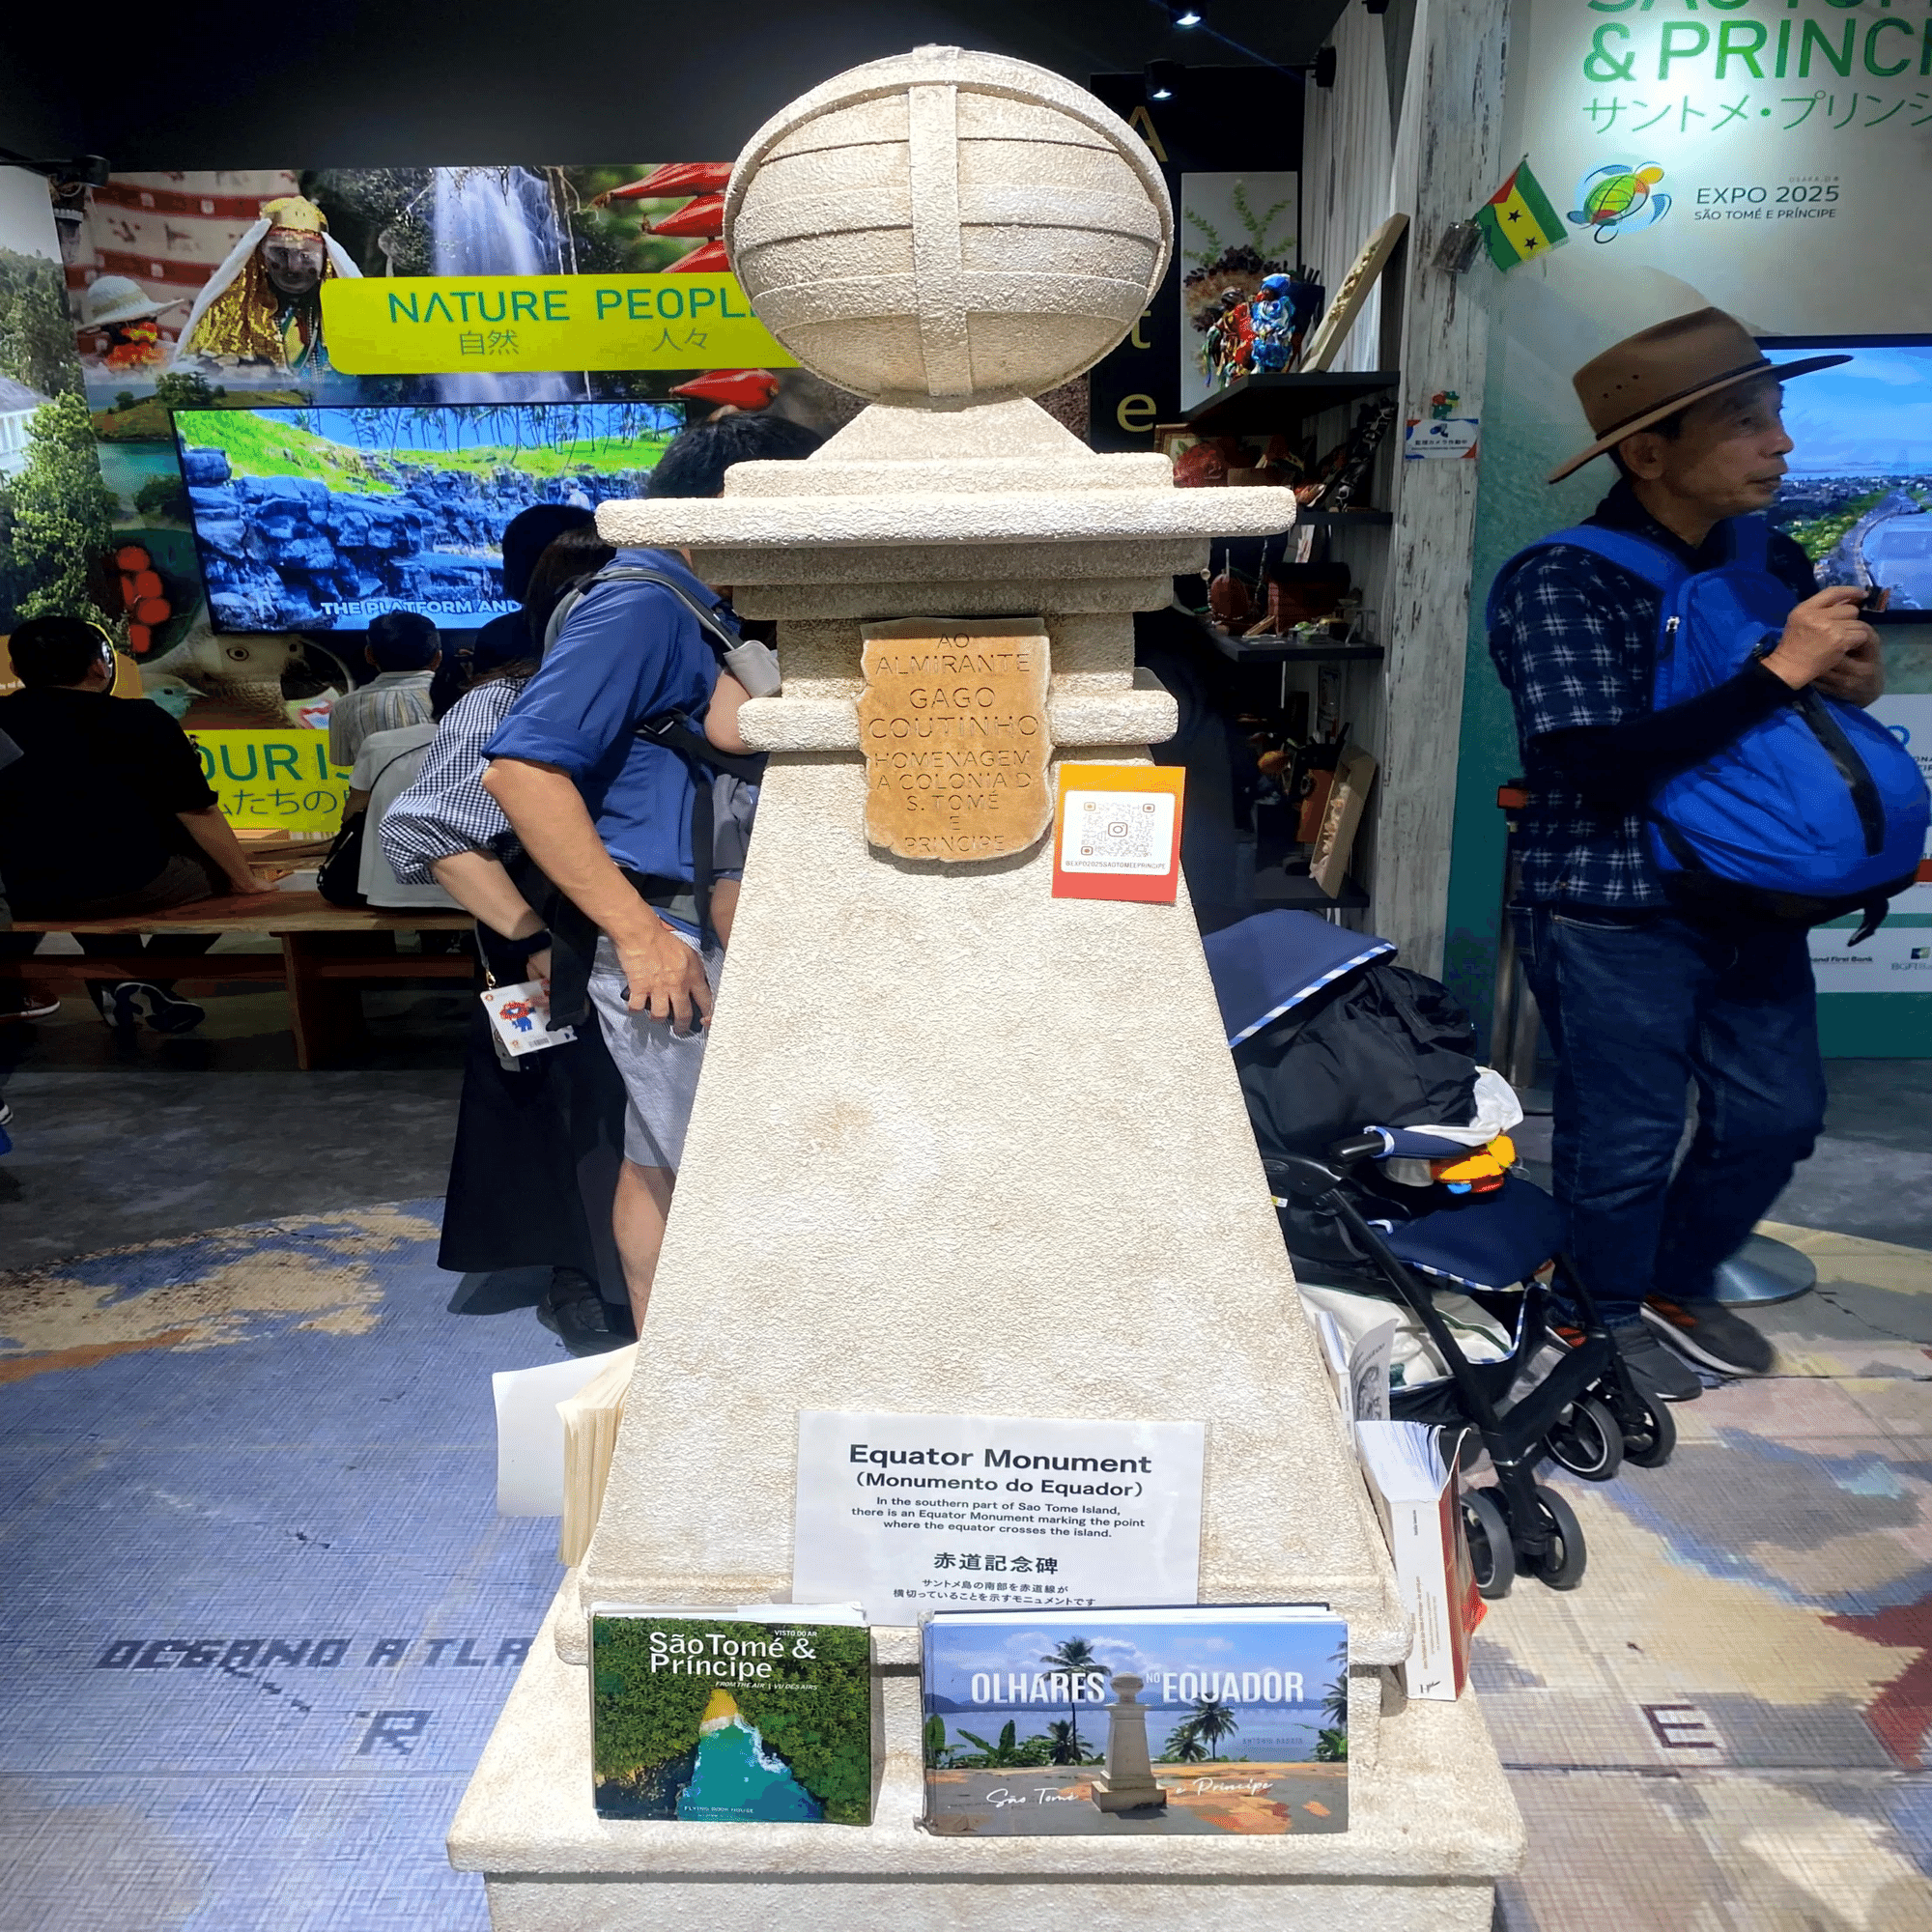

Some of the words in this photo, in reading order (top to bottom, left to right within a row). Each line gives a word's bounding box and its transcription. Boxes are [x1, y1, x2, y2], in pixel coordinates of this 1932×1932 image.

[1582, 21, 1636, 82] &
[1696, 186, 1767, 204] EXPO
[1776, 185, 1839, 203] 2025
[1694, 209, 1721, 220] SÃO
[1725, 208, 1762, 219] TOMÉ
[1766, 210, 1774, 219] E
[1777, 207, 1836, 218] PRÍNCIPE
[388, 290, 570, 324] NATURE
[596, 287, 756, 320] PEOPL
[459, 329, 519, 355] 自然
[651, 327, 709, 353] 人々
[321, 602, 361, 615] THE
[367, 600, 473, 614] PLATFORM
[475, 600, 524, 613] AND
[937, 633, 970, 649] AO
[875, 653, 1030, 674] ALMIRANTE
[909, 687, 996, 709] GAGO
[868, 716, 1039, 739] COUTINHO
[316, 743, 351, 781] I
[874, 751, 1030, 769] HOMENAGEM
[876, 775, 891, 790] A
[898, 773, 1009, 790] COLONIA
[222, 788, 351, 815] たちの
[906, 795, 925, 811] S.
[931, 790, 999, 810] TOMÉ
[950, 815, 961, 831] E
[904, 836, 1005, 853] PRINCIPE
[850, 1443, 974, 1468] Equator
[984, 1448, 1151, 1473] Monument
[857, 1471, 998, 1491] (Monumento
[1006, 1478, 1034, 1492] do
[1041, 1479, 1143, 1497] Equador)
[876, 1496, 888, 1505] In
[892, 1497, 911, 1506] the
[915, 1498, 969, 1508] southern
[973, 1501, 998, 1510] part
[1018, 1502, 1040, 1511] Sao
[1045, 1503, 1078, 1513] Tome
[1082, 1505, 1121, 1516] Island,
[851, 1507, 884, 1517] there
[919, 1509, 966, 1520] Equator
[970, 1512, 1034, 1522] Monument
[1037, 1516, 1086, 1526] marking
[1090, 1518, 1110, 1526] the
[1114, 1519, 1145, 1528] point
[883, 1520, 921, 1529] where
[924, 1520, 944, 1530] the
[948, 1522, 995, 1532] equator
[999, 1525, 1046, 1535] crosses
[1050, 1527, 1070, 1536] the
[1073, 1528, 1112, 1538] island.
[934, 1551, 1059, 1575] 赤道記念碑
[893, 1588, 1095, 1605] 横切っていることを示すモニュメントです
[922, 1578, 1068, 1594] サントメ島の南部を赤道線が
[649, 1632, 704, 1655] São
[705, 1634, 784, 1658] Tomé
[791, 1637, 817, 1660] &
[651, 1653, 773, 1681] Príncipe
[971, 1671, 1105, 1705] OLHARES
[1146, 1672, 1159, 1685] NO
[1162, 1670, 1304, 1703] EQUADOR
[985, 1788, 1026, 1808] São
[1176, 1785, 1185, 1794] e
